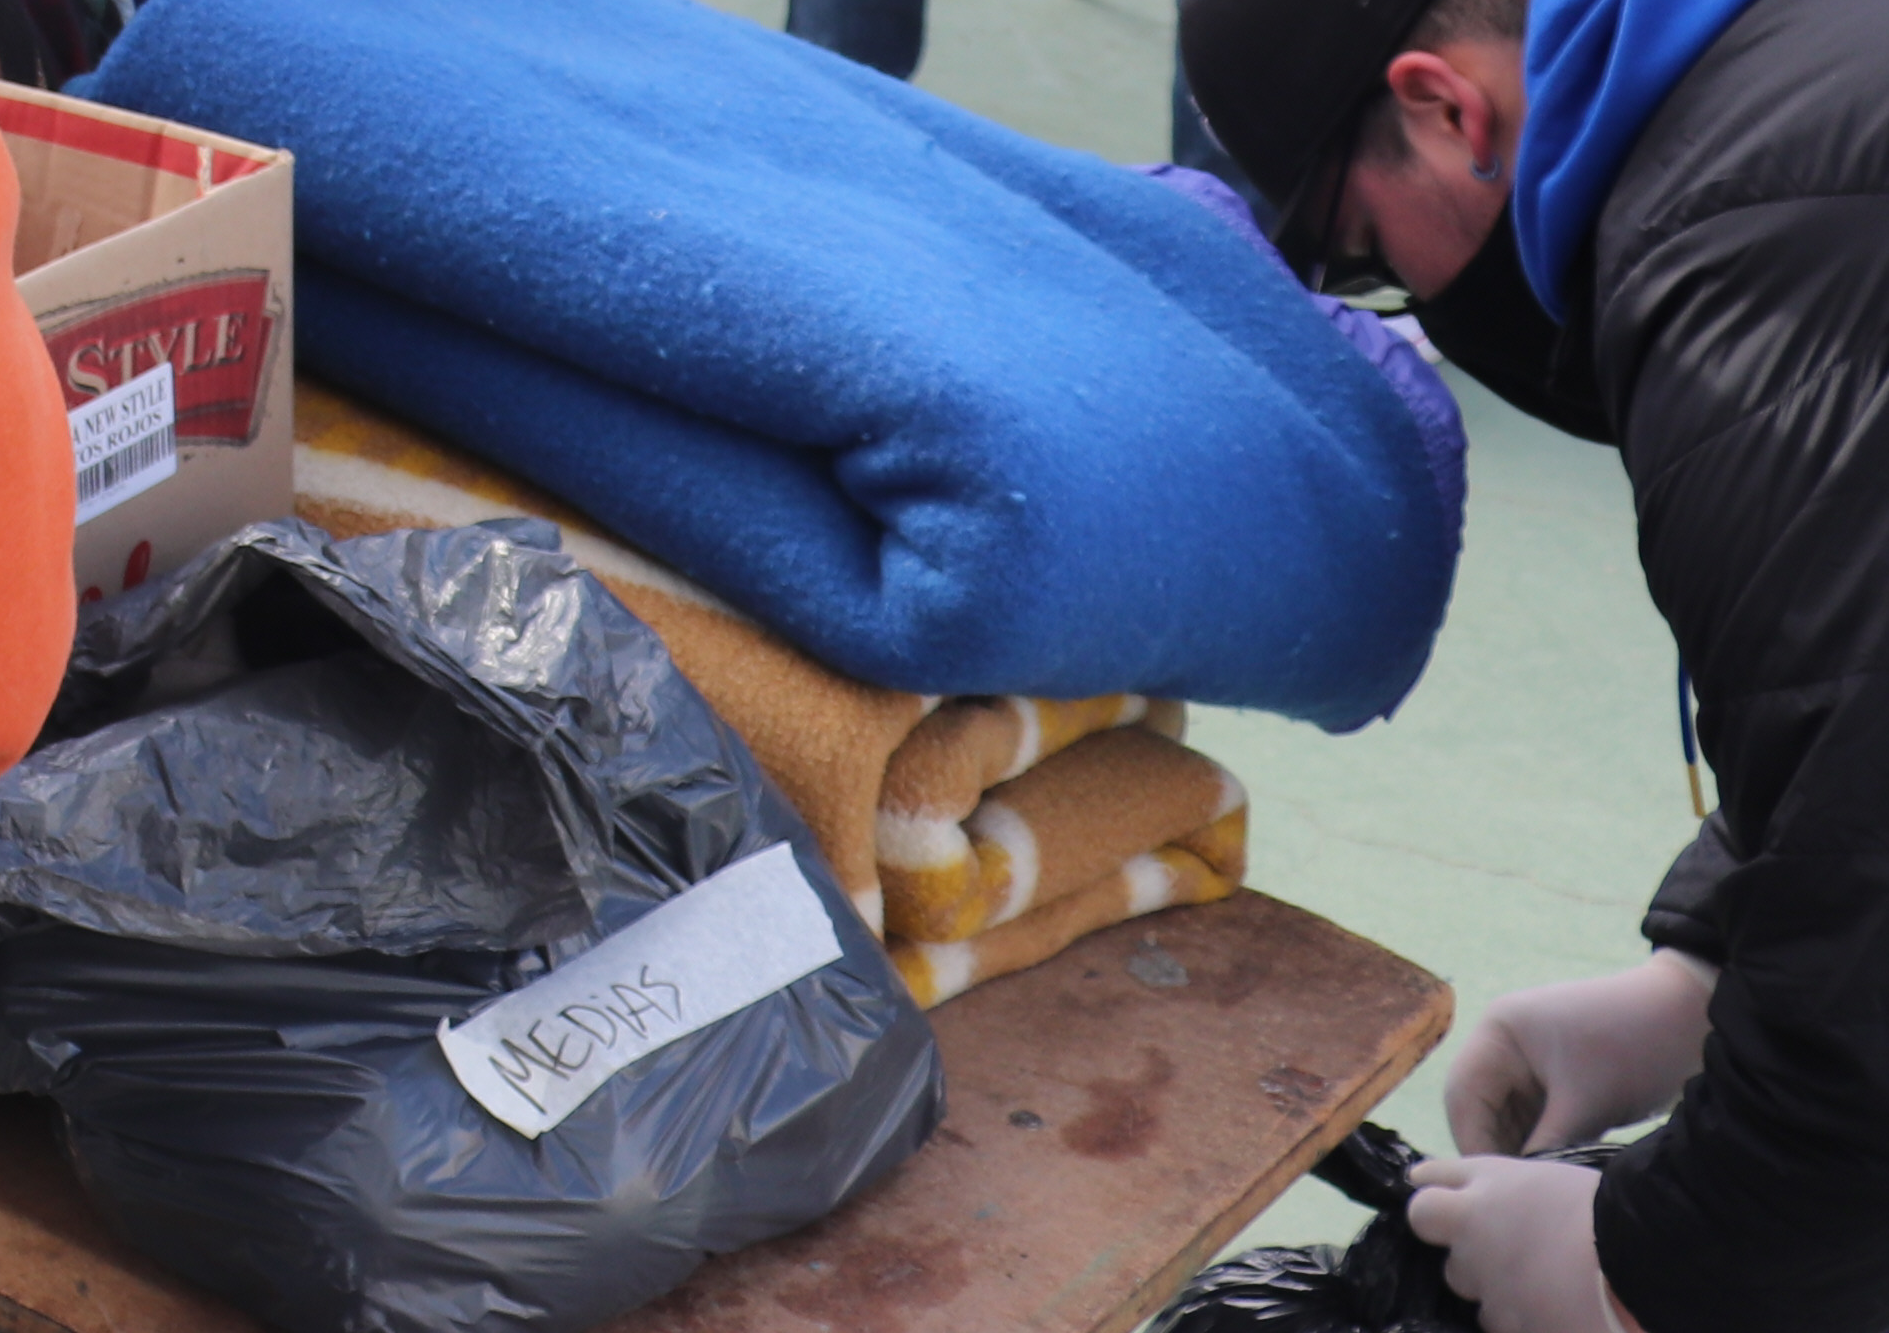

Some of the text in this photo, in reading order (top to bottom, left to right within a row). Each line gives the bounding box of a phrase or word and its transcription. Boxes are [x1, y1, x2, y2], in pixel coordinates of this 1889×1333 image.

[84, 405, 119, 440] NEW
[121, 377, 168, 420] STYLE
[107, 410, 164, 454] ROJOS
